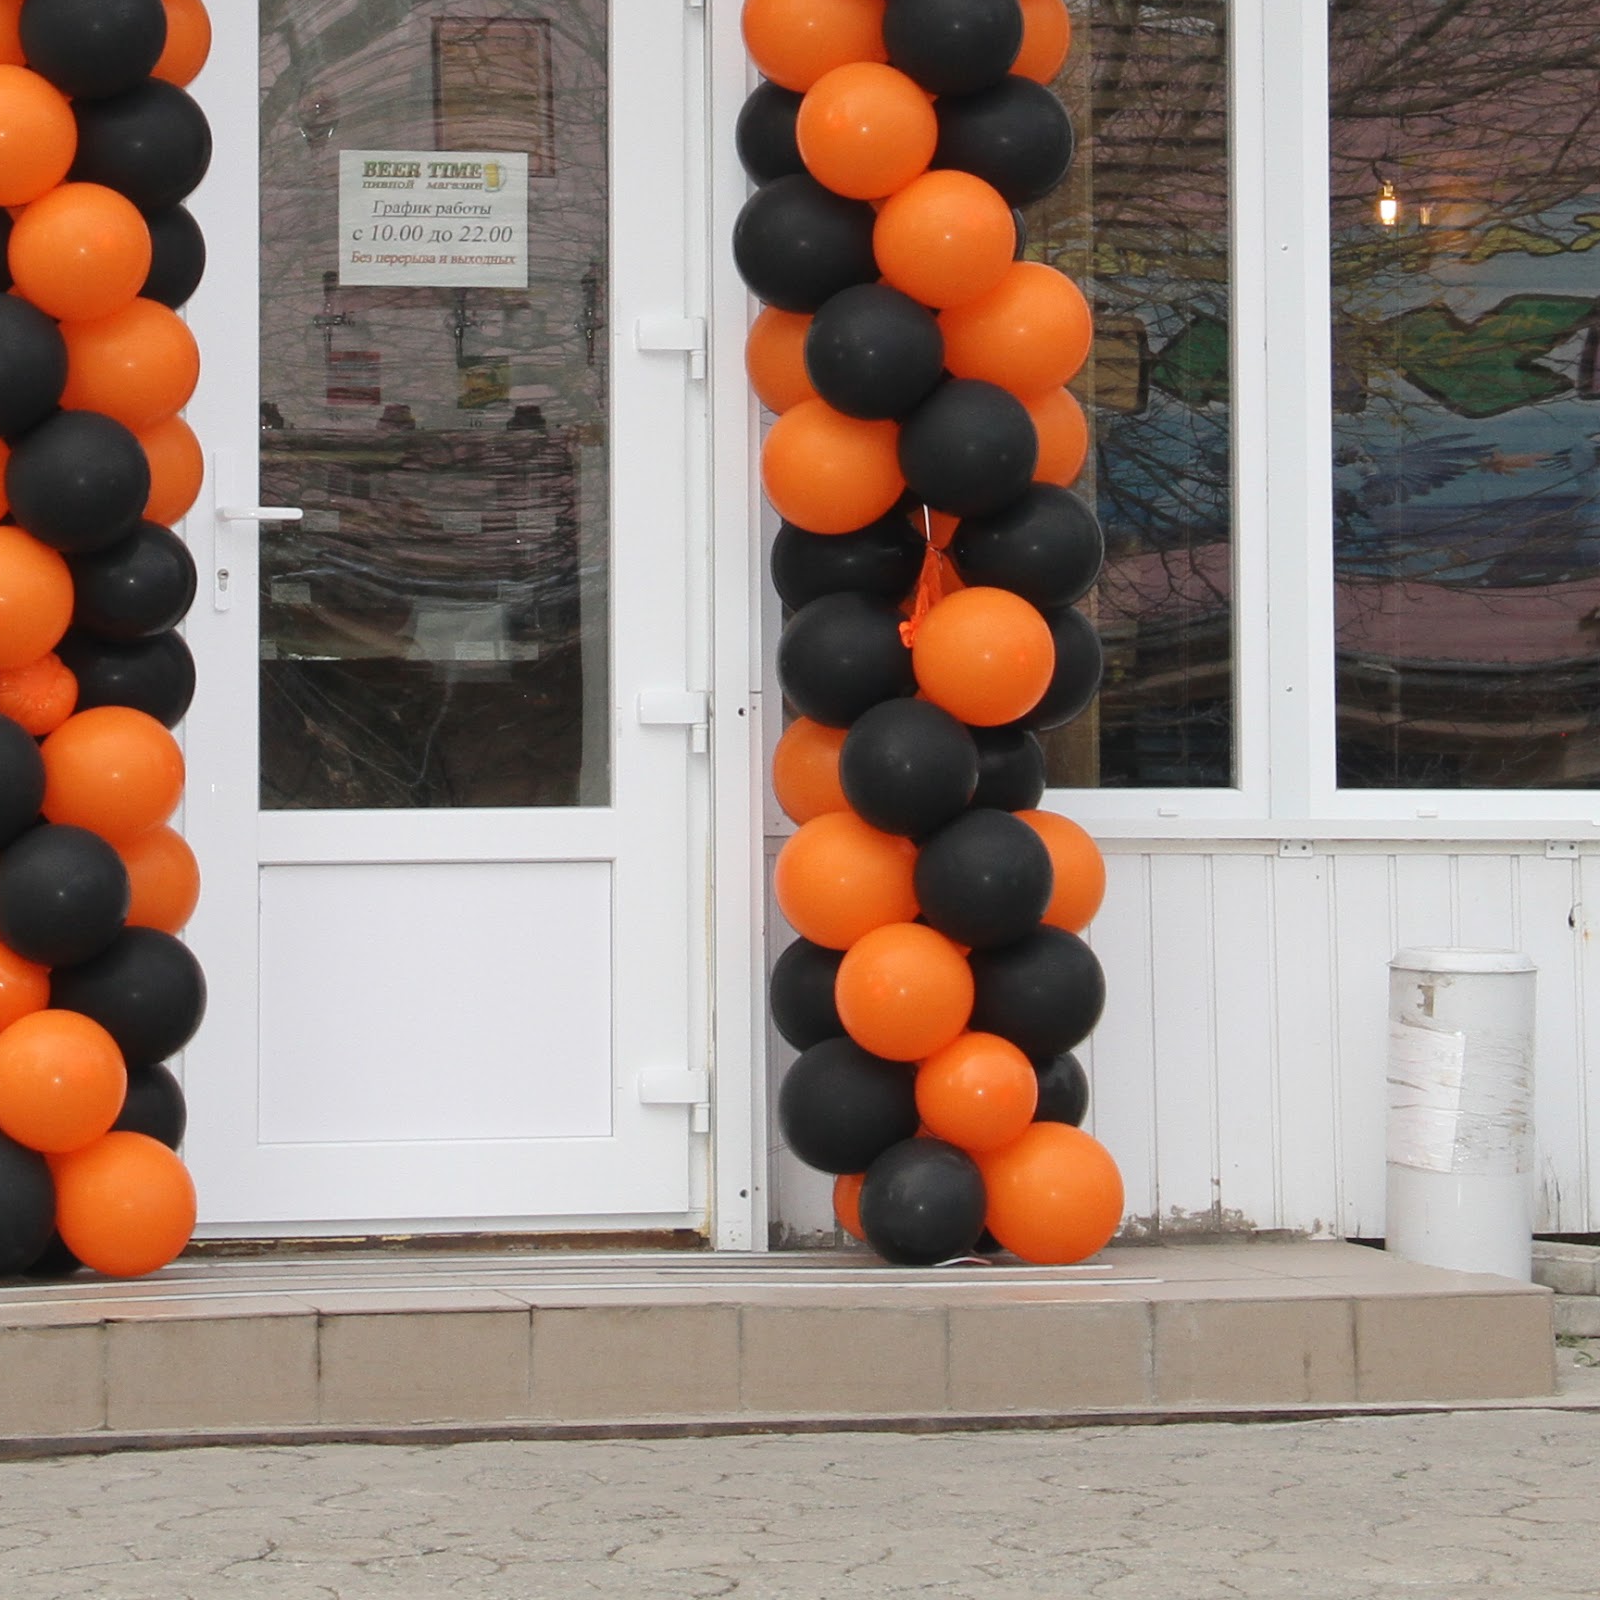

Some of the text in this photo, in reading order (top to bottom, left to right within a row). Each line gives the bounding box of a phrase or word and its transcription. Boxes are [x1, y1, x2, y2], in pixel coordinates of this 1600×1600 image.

[362, 160, 483, 179] BEER TIME
[362, 179, 484, 191] пивной магазин
[372, 200, 493, 218] График работы
[352, 224, 513, 244] с 10.00 до 22.00
[351, 250, 517, 267] Без перерыва и выходных
